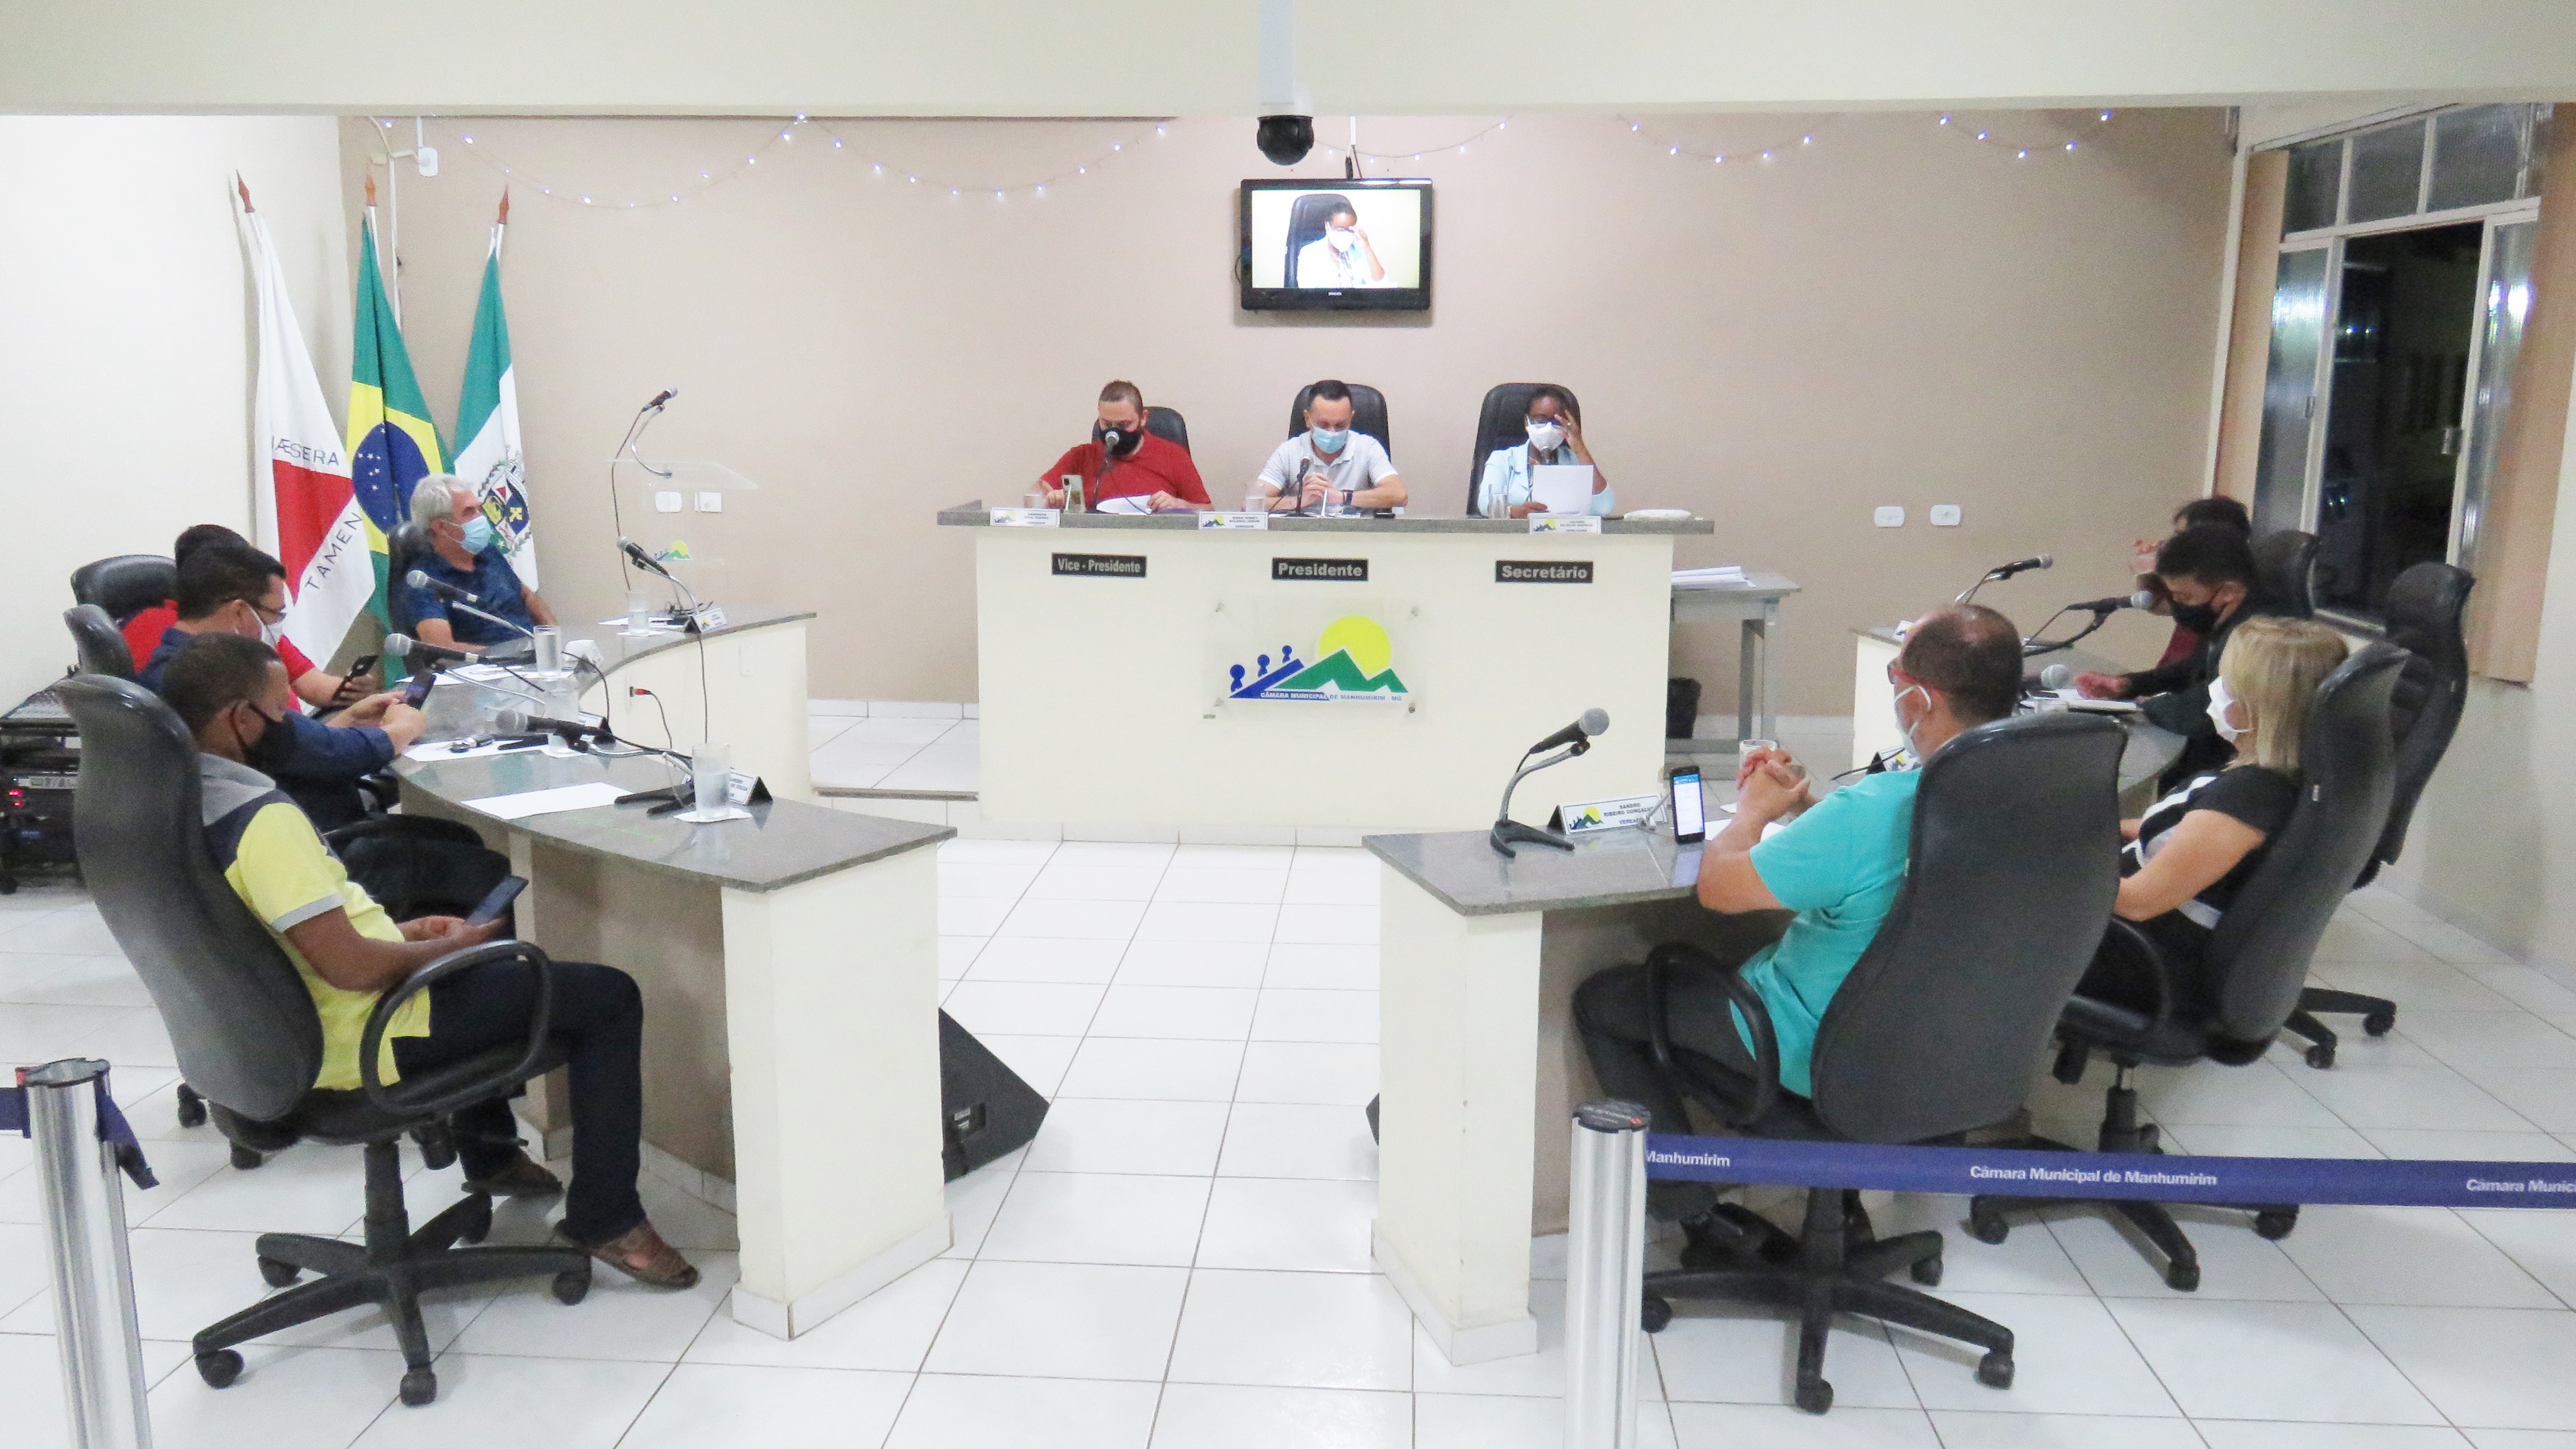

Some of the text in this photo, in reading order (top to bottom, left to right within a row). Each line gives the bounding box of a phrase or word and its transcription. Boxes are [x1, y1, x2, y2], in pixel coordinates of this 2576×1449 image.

[305, 512, 362, 590] TAMEN
[1058, 558, 1080, 571] Vice
[1088, 558, 1140, 573] Presidente
[1278, 562, 1363, 577] Presidente
[1502, 565, 1588, 579] Secretário
[1260, 690, 1289, 699] CÂMARA
[1290, 692, 1327, 700] MUNICIPAL
[1646, 1150, 1730, 1167] Manhumirim
[1969, 1165, 2217, 1186] Câmara Municipal de Manhumirim
